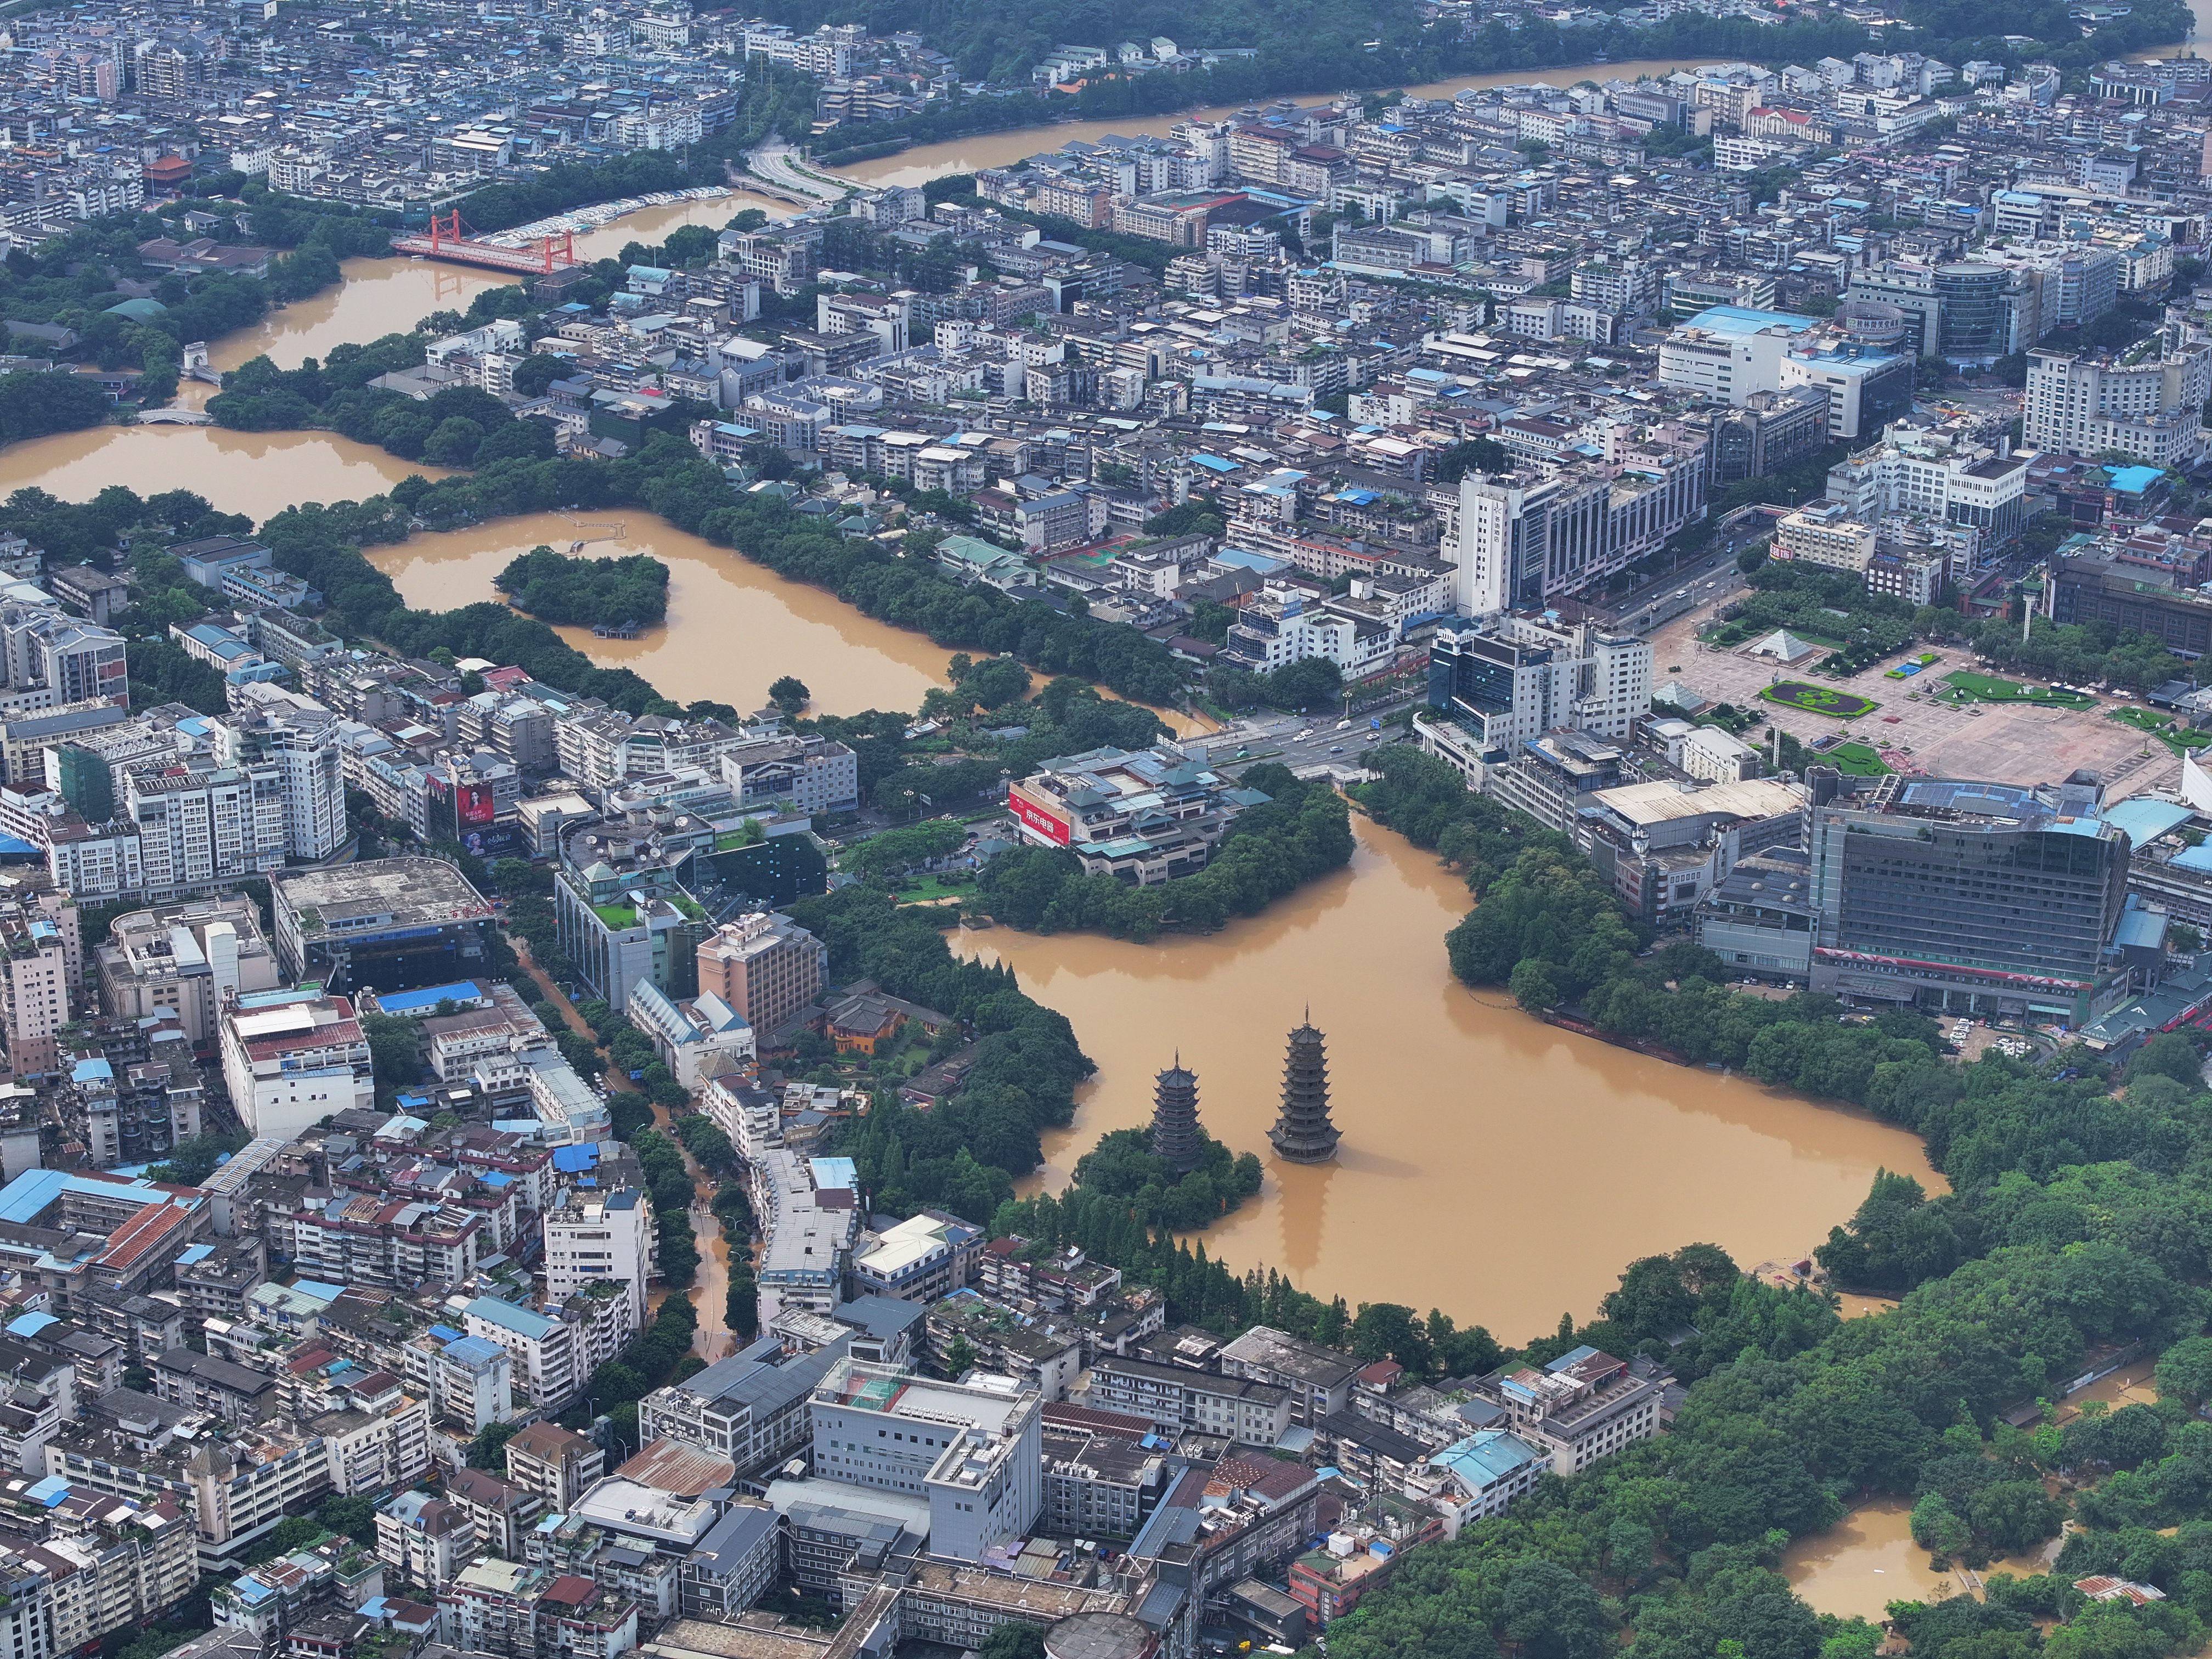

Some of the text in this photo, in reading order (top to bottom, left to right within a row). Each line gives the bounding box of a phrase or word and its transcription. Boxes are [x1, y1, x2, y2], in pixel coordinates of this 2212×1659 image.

[1026, 809, 1053, 833] 京东电器
[449, 904, 496, 918] 百货大楼
